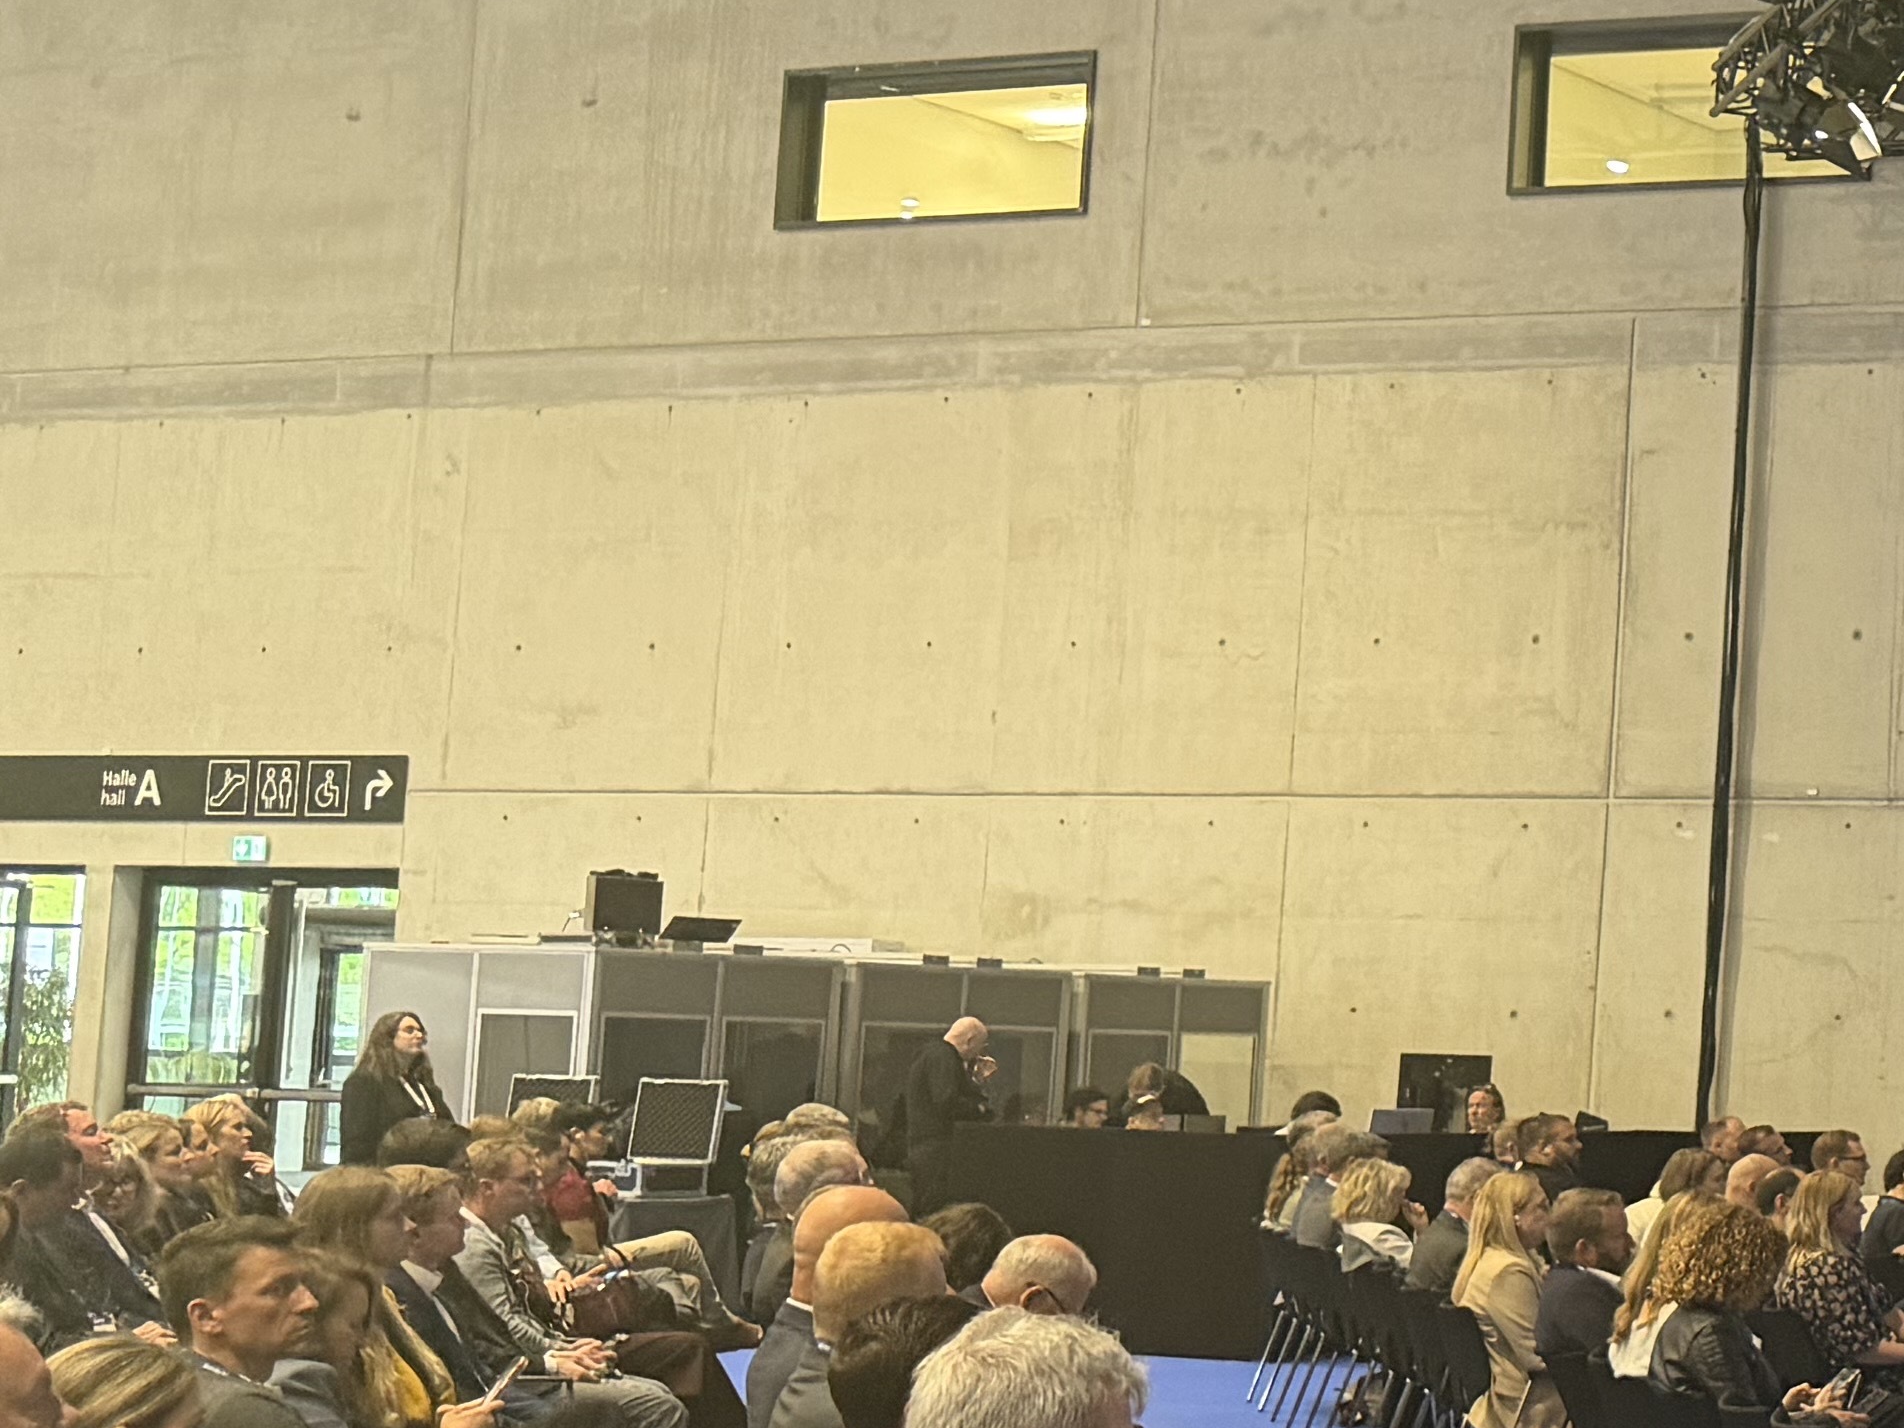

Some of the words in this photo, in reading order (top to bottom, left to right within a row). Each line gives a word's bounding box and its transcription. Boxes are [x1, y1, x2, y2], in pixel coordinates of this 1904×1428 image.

[100, 788, 126, 806] hall
[103, 769, 137, 787] Halle
[131, 769, 162, 806] A
